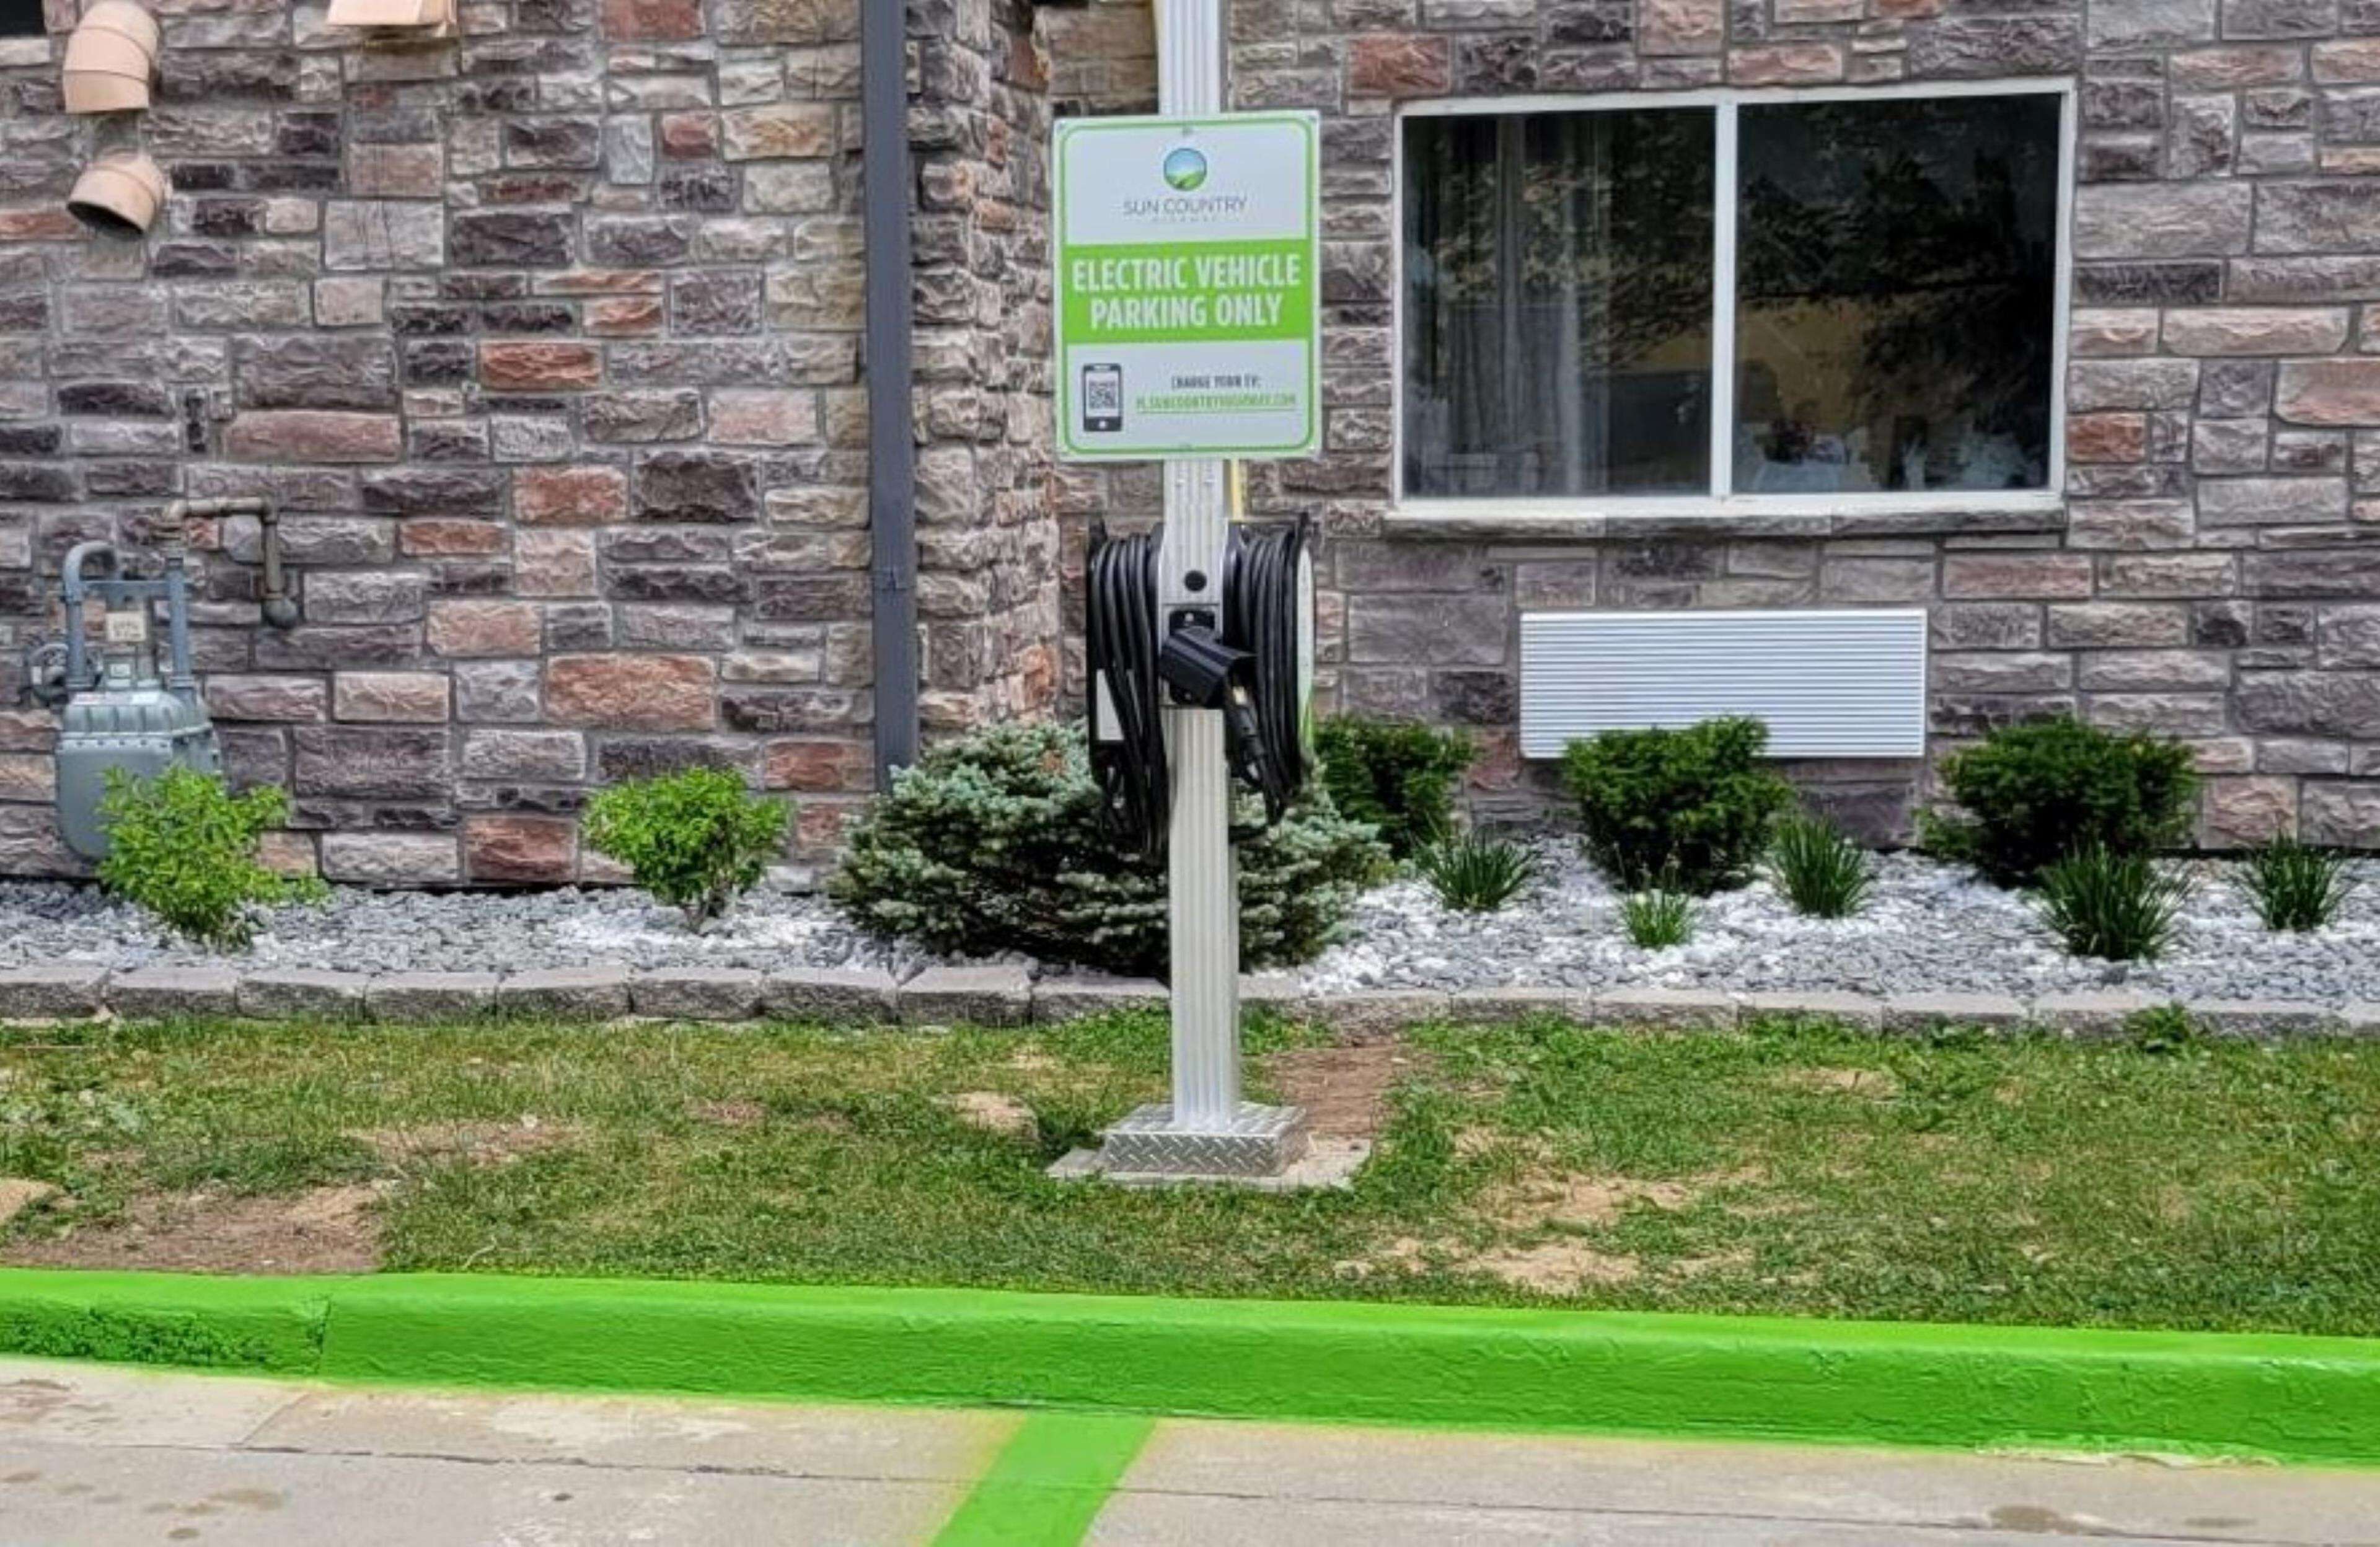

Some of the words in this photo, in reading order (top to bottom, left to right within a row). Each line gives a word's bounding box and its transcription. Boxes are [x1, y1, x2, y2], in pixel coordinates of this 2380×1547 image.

[1123, 200, 1159, 215] SUN
[1164, 195, 1247, 214] COUNTRY
[1073, 258, 1188, 291] ELECTRIC
[1195, 254, 1301, 288] VEHICLE
[1091, 297, 1207, 329] PARKING
[1216, 294, 1282, 326] ONLY
